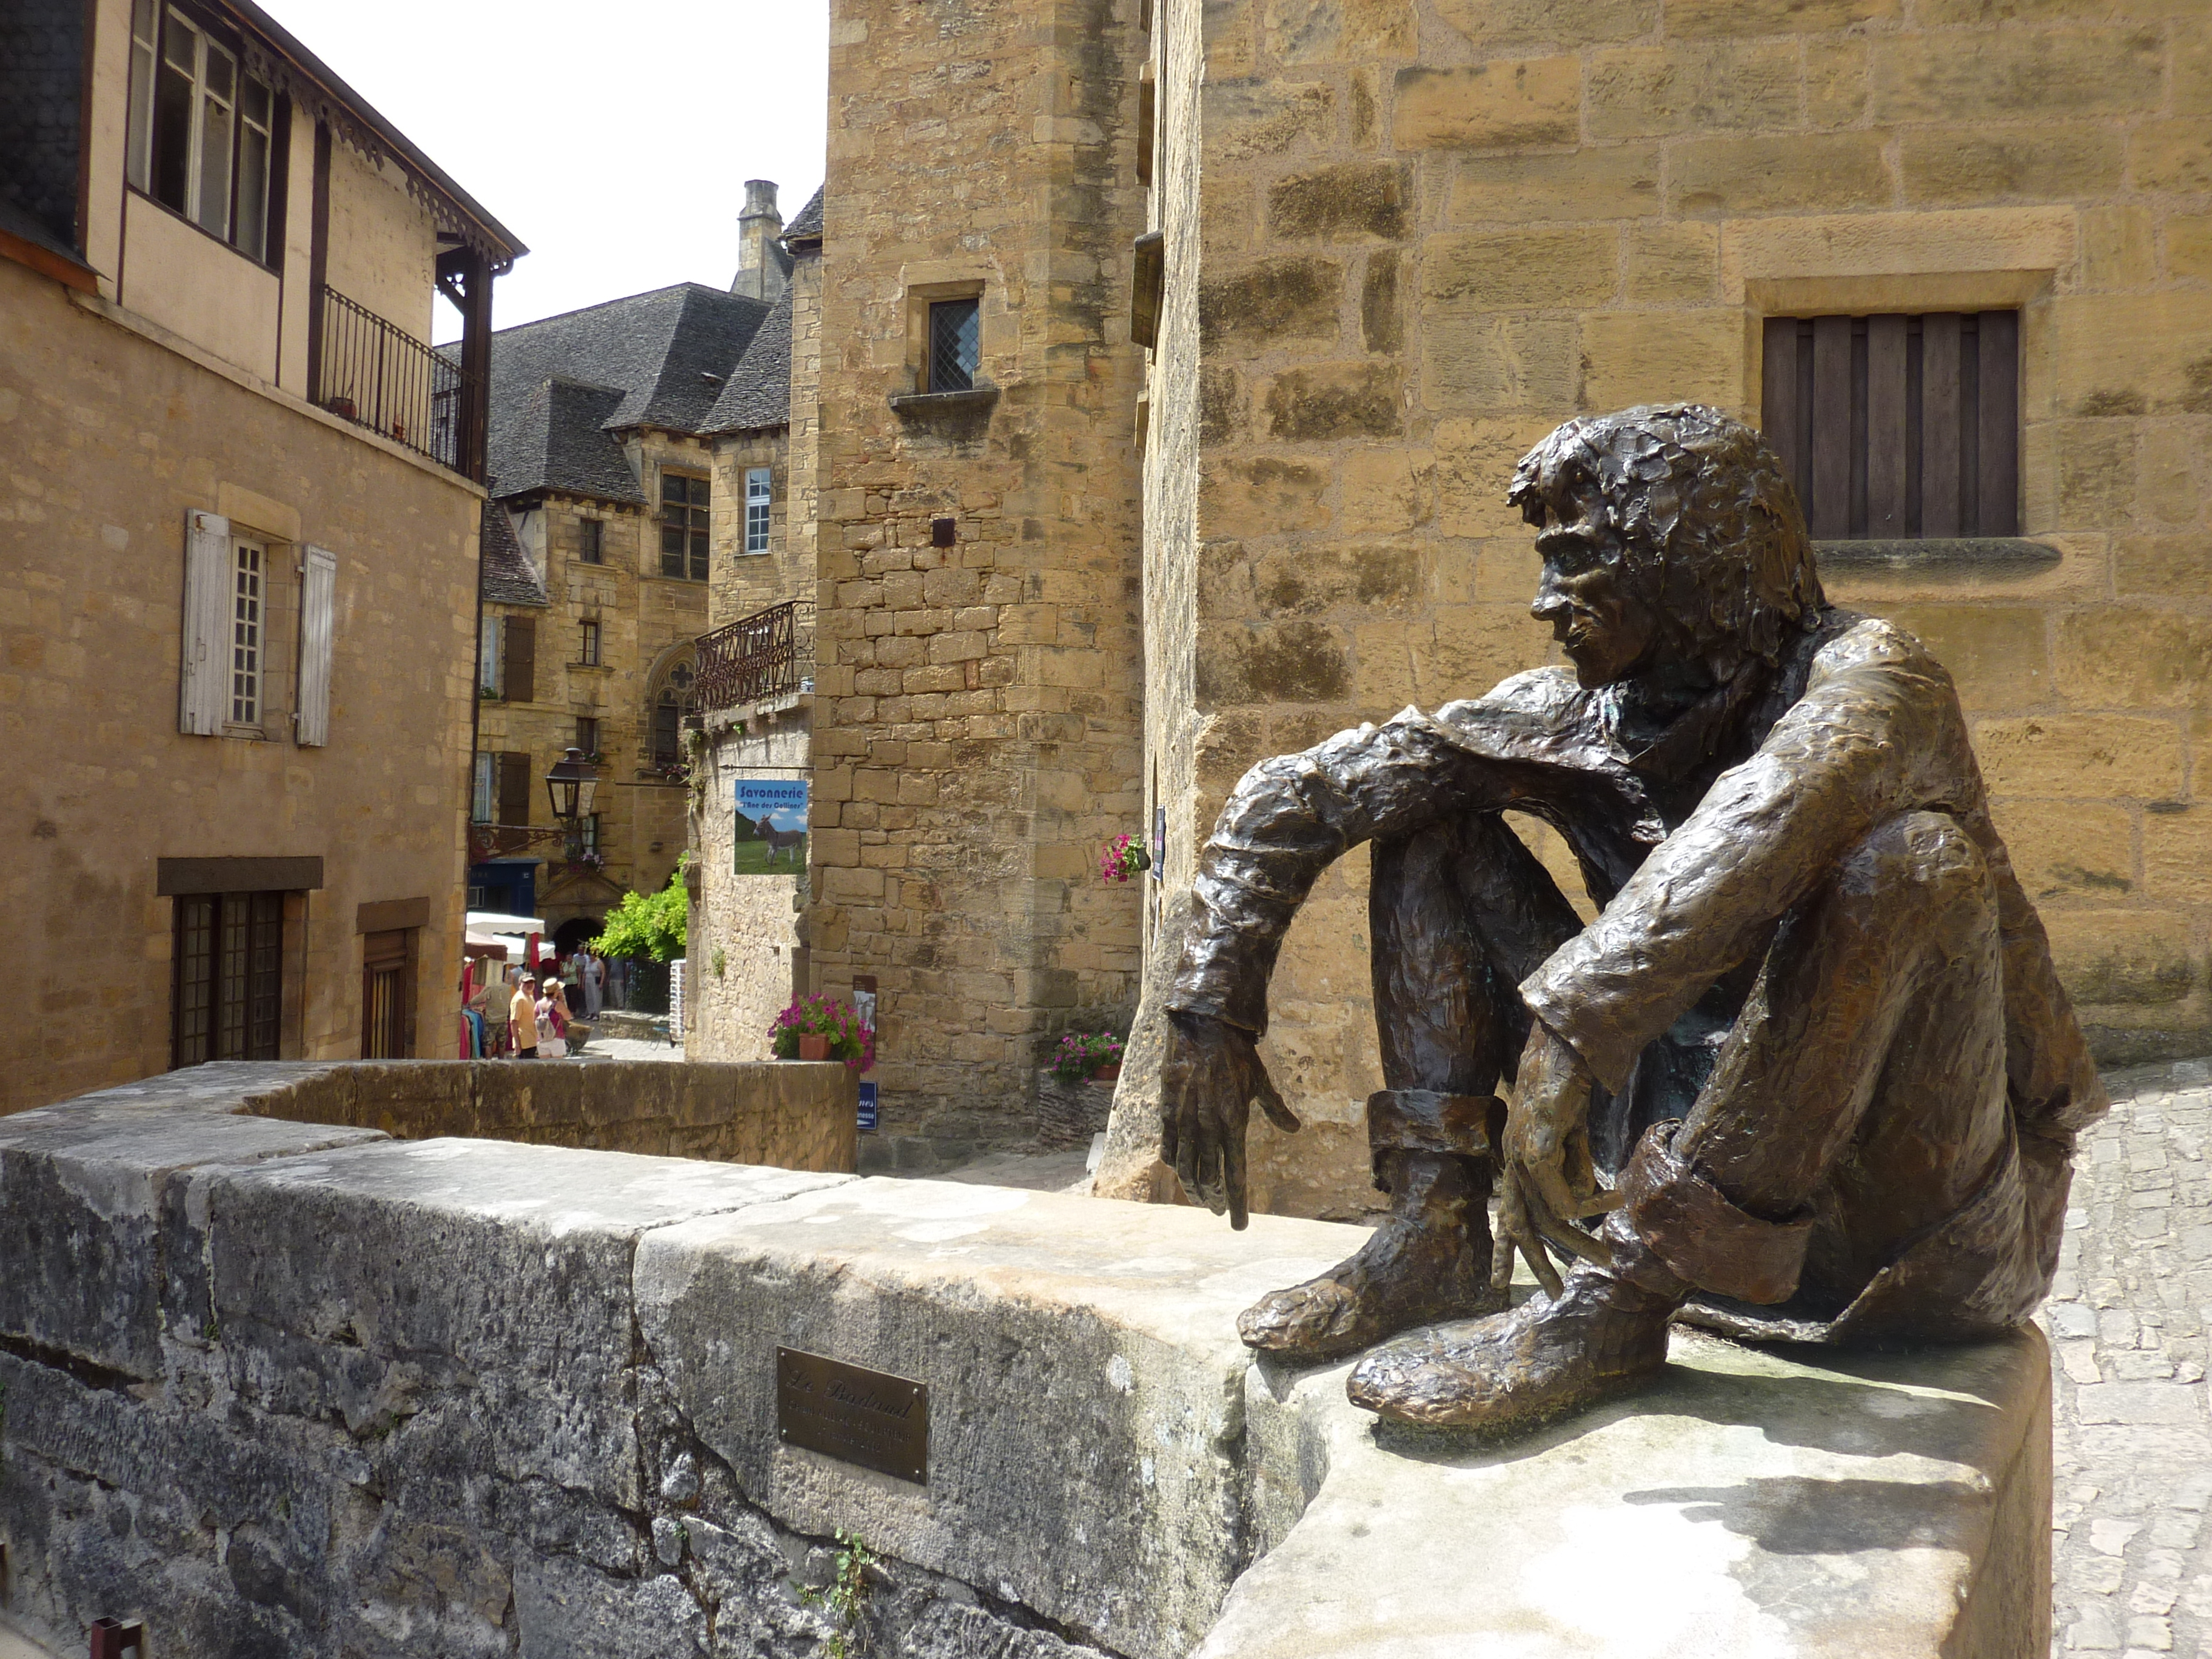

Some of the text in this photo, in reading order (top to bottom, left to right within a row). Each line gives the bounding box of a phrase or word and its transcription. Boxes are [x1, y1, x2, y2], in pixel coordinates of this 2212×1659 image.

[740, 786, 803, 799] Savonnerie
[786, 1370, 814, 1393] Le
[823, 1379, 914, 1421] Badaud
